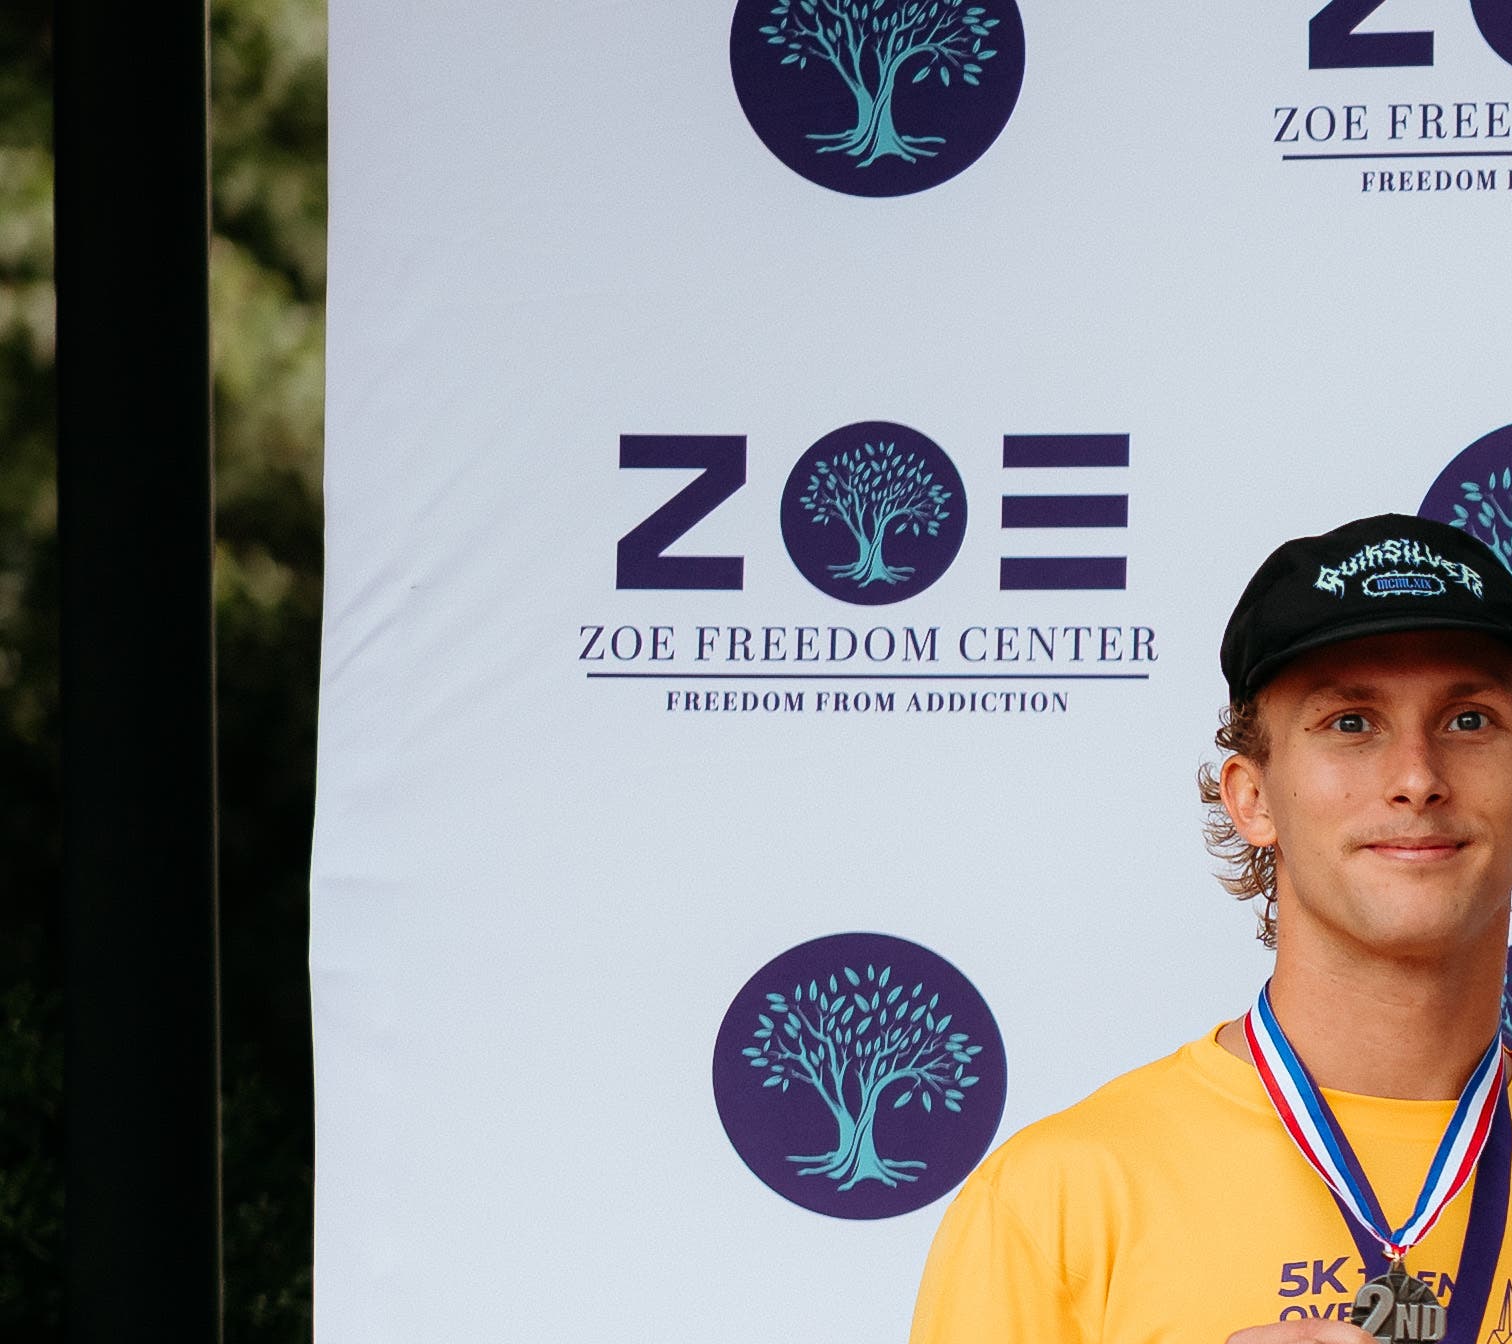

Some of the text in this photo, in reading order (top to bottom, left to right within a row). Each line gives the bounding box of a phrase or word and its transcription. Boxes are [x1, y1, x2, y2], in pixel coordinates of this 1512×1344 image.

[1272, 104, 1370, 144] ZOE
[1360, 168, 1498, 194] FREEDOM
[615, 420, 1131, 607] ZOE
[577, 624, 1160, 663] ZOE FREEDOM CENTER
[665, 690, 1068, 714] FREEDOM FROM ADDICTION
[1278, 1256, 1350, 1298] 5K
